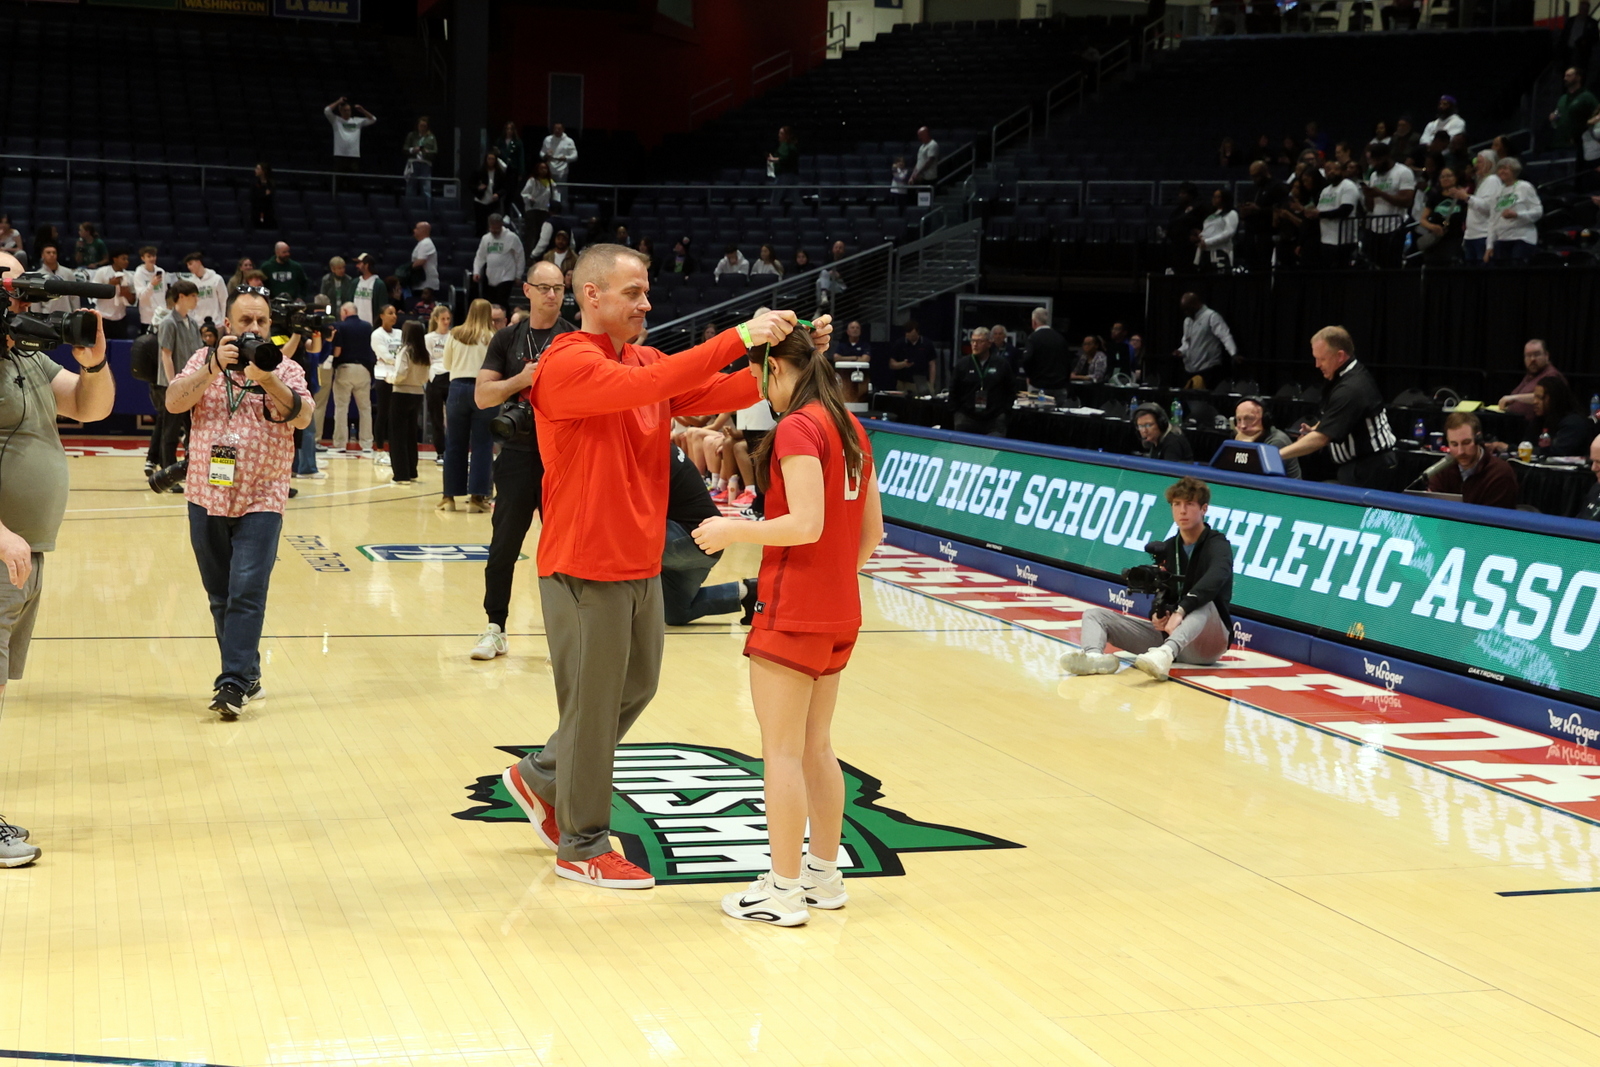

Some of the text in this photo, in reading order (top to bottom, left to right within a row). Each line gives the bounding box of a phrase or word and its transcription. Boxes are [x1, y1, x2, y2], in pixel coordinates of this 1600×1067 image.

[184, 0, 266, 12] WASHINGTON
[285, 0, 304, 11] LA
[21, 340, 40, 348] Canon
[1234, 452, 1249, 465] POSS
[877, 449, 943, 504] OHIO
[935, 459, 1022, 521] HIGH
[1015, 474, 1157, 552] SCHOOL
[1115, 590, 1135, 613] Kroger
[1375, 660, 1404, 690] Kroger
[1467, 667, 1505, 682] DAKTRONICS
[1563, 712, 1600, 746] Kroger
